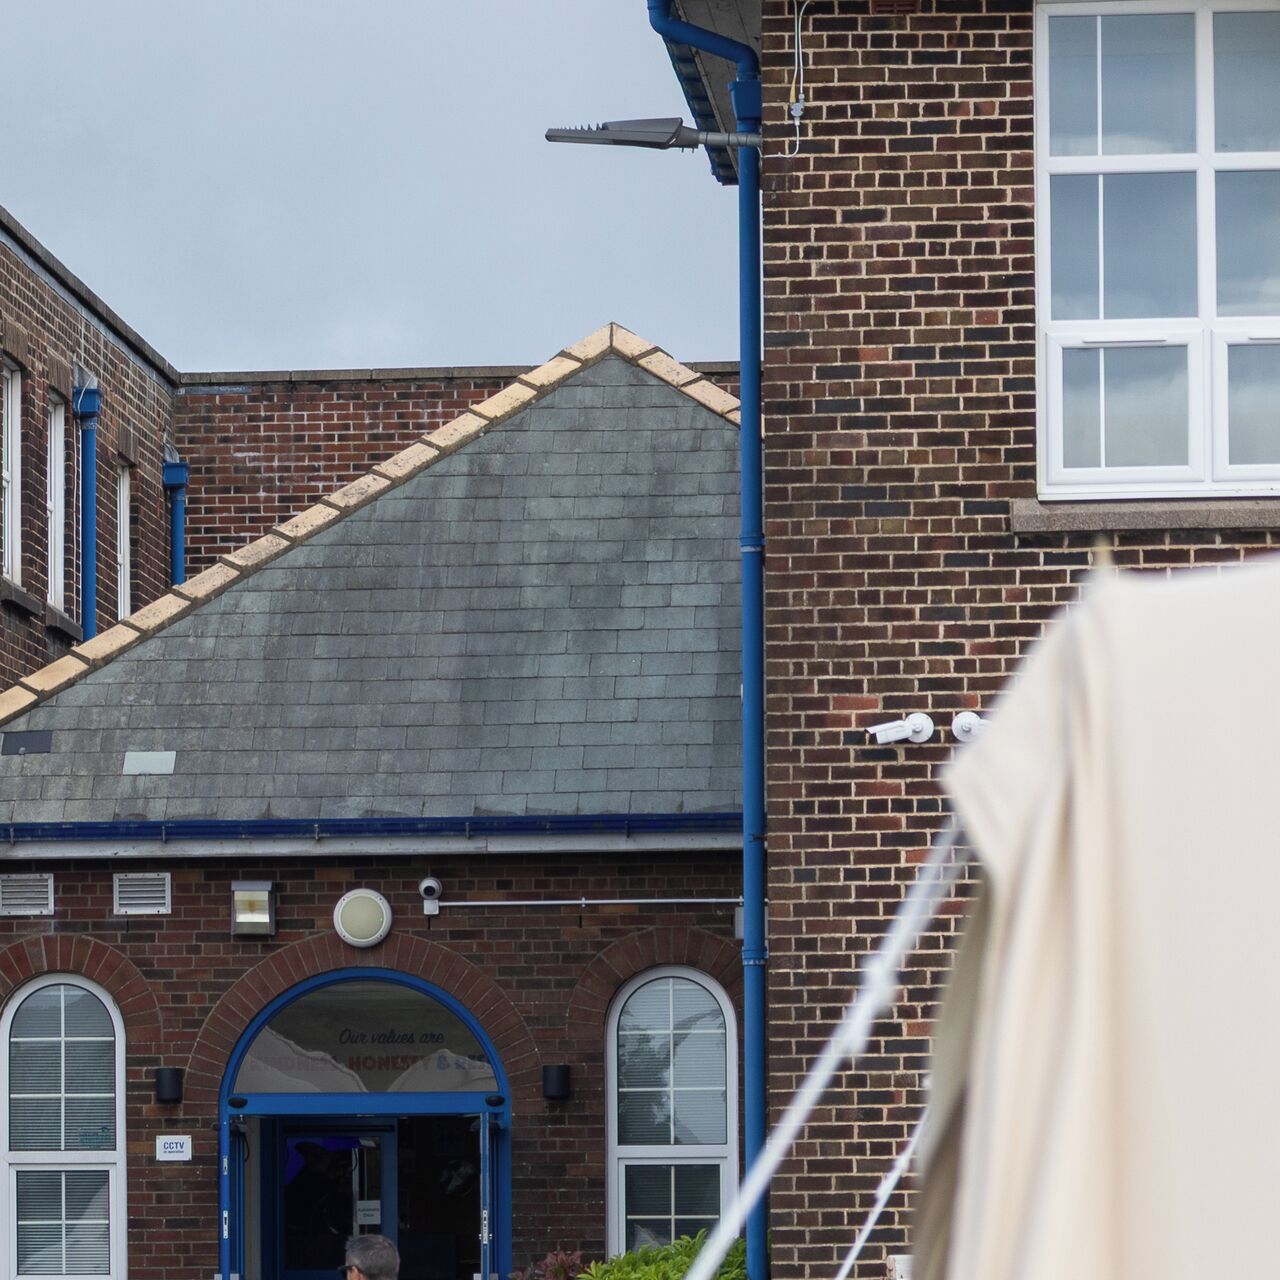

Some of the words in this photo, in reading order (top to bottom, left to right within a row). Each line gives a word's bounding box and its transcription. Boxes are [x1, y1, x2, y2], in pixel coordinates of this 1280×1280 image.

[338, 1028, 367, 1044] Our
[370, 1028, 415, 1044] values
[418, 1032, 445, 1044] are
[163, 1141, 185, 1150] CCTV
